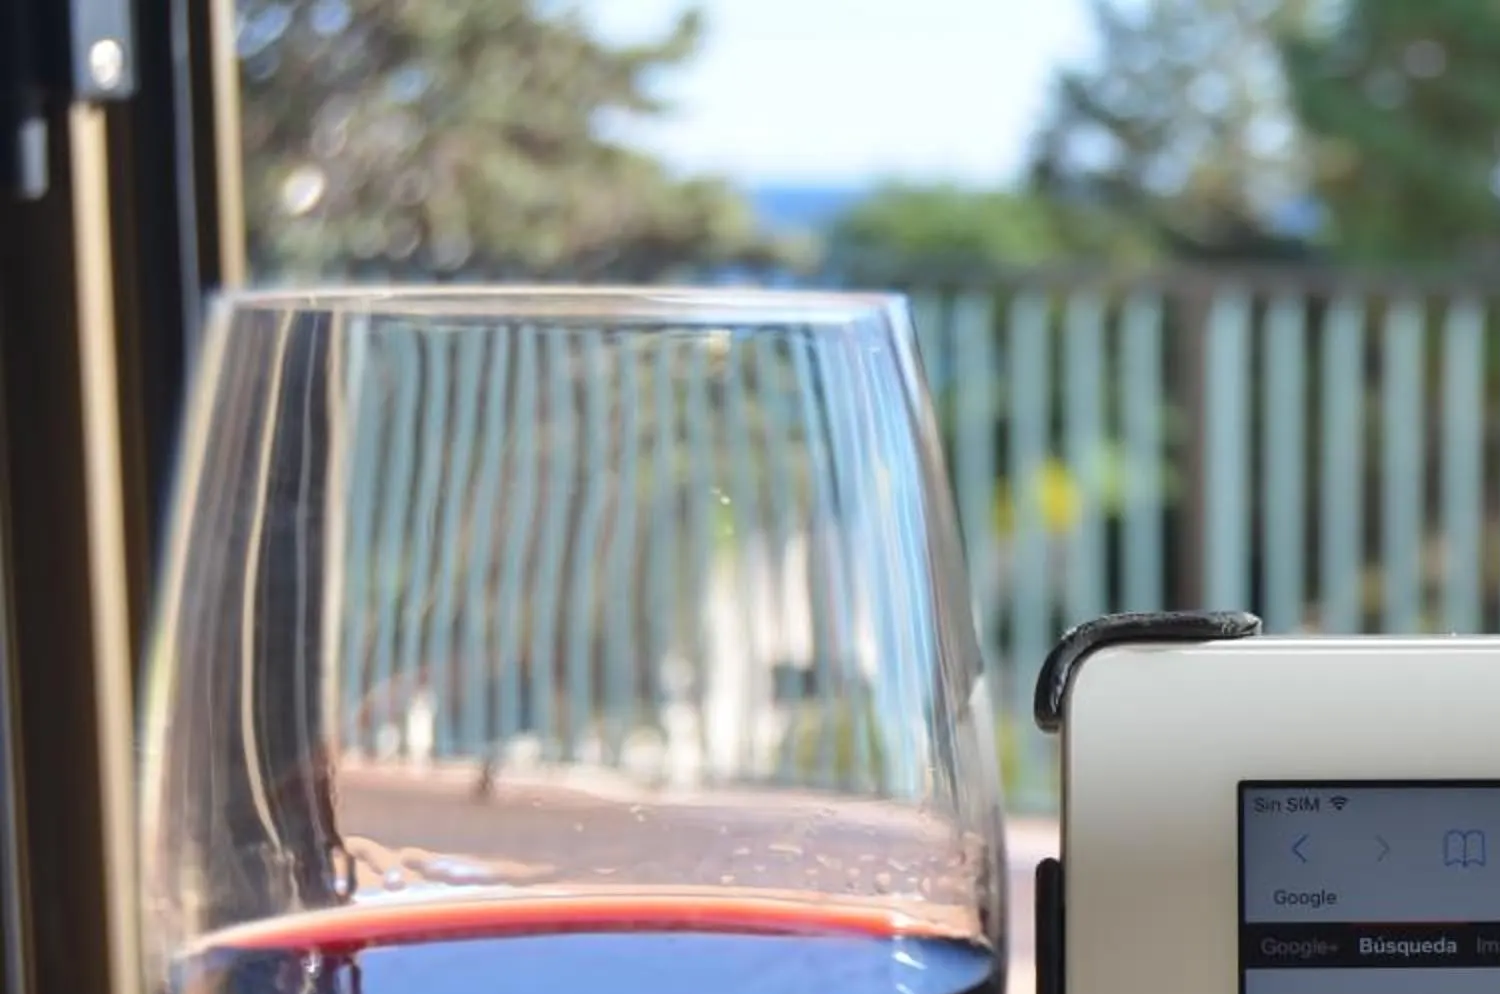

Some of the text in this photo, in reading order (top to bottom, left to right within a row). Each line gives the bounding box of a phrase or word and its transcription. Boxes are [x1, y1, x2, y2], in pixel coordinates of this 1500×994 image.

[1253, 796, 1321, 813] Sin SIM
[1273, 888, 1337, 908] Google
[1359, 934, 1458, 956] Búsqueda
